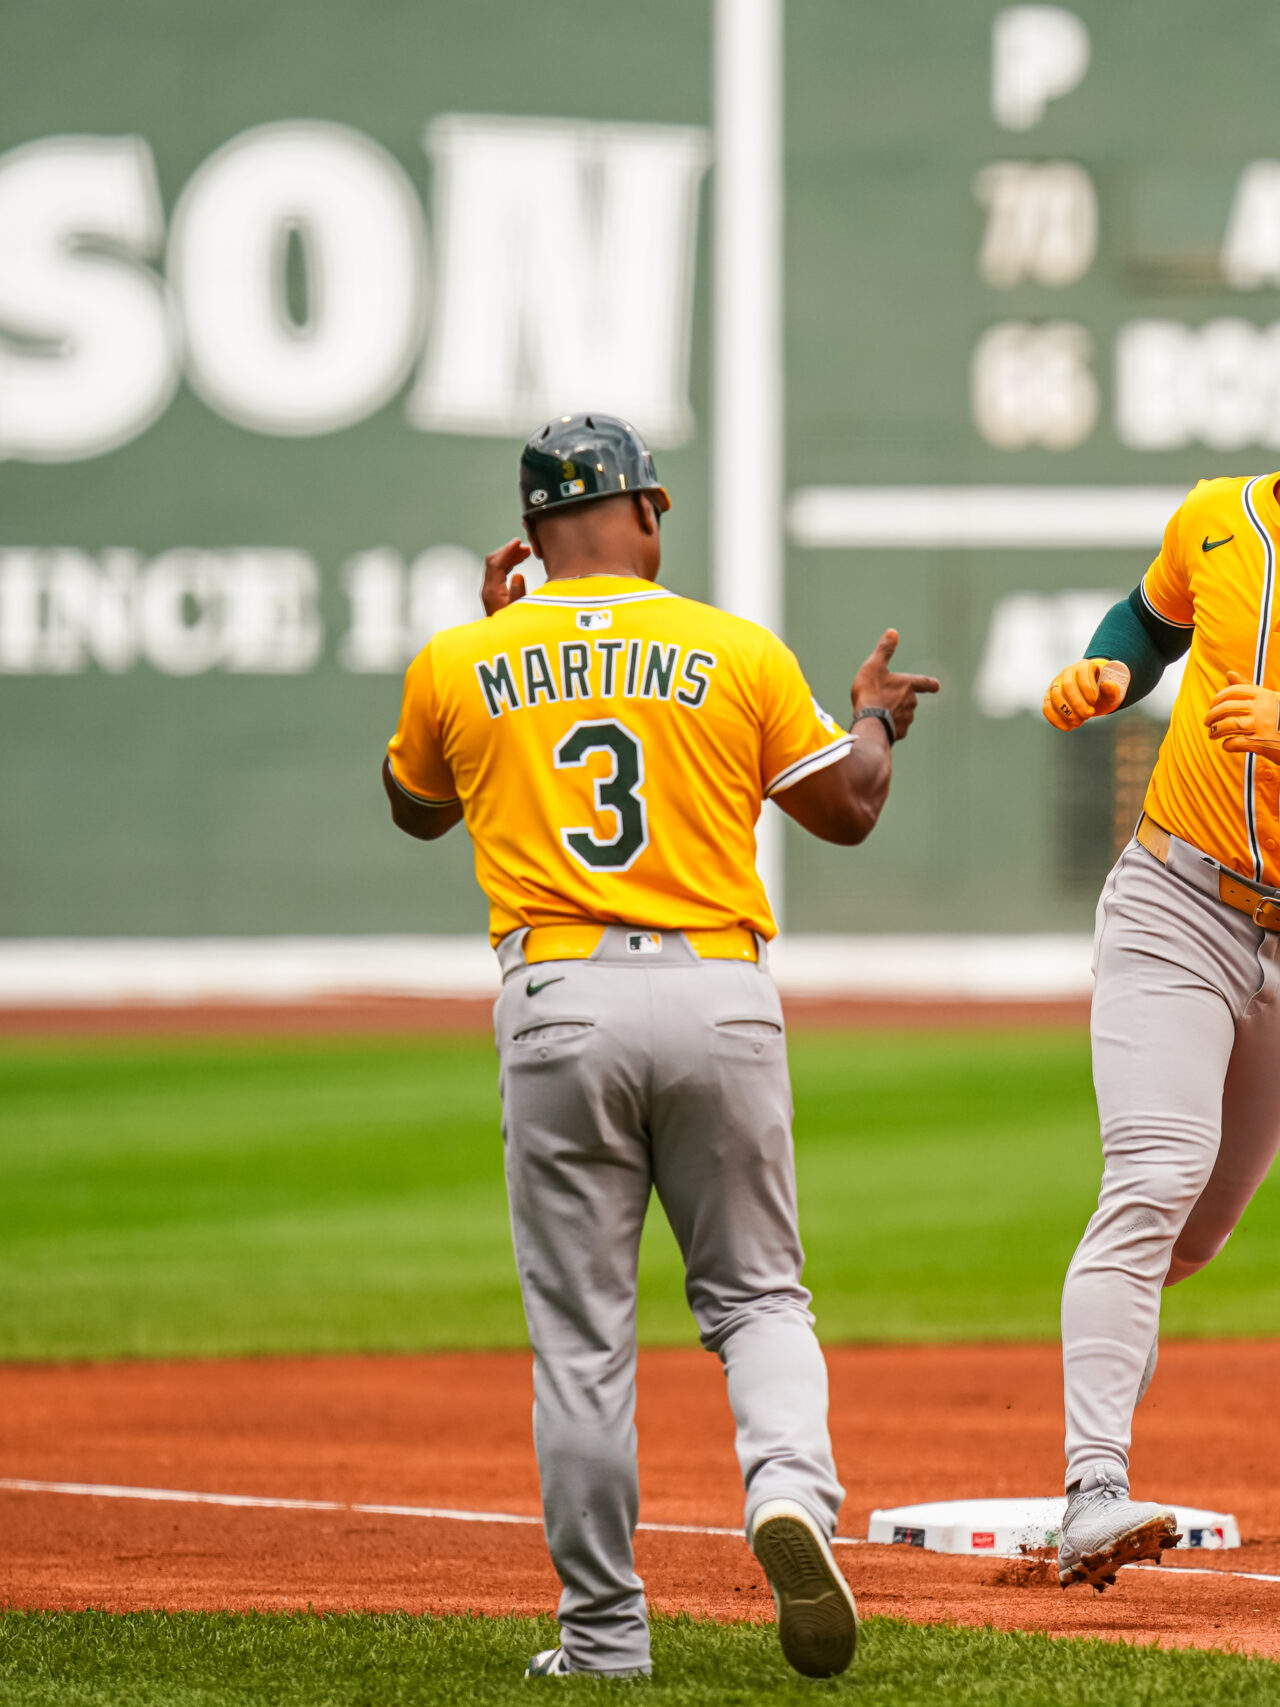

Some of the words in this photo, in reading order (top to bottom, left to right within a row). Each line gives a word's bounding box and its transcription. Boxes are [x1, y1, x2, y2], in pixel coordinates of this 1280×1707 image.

[990, 3, 1090, 130] P
[474, 638, 718, 720] MARTINS
[554, 717, 650, 873] 3
